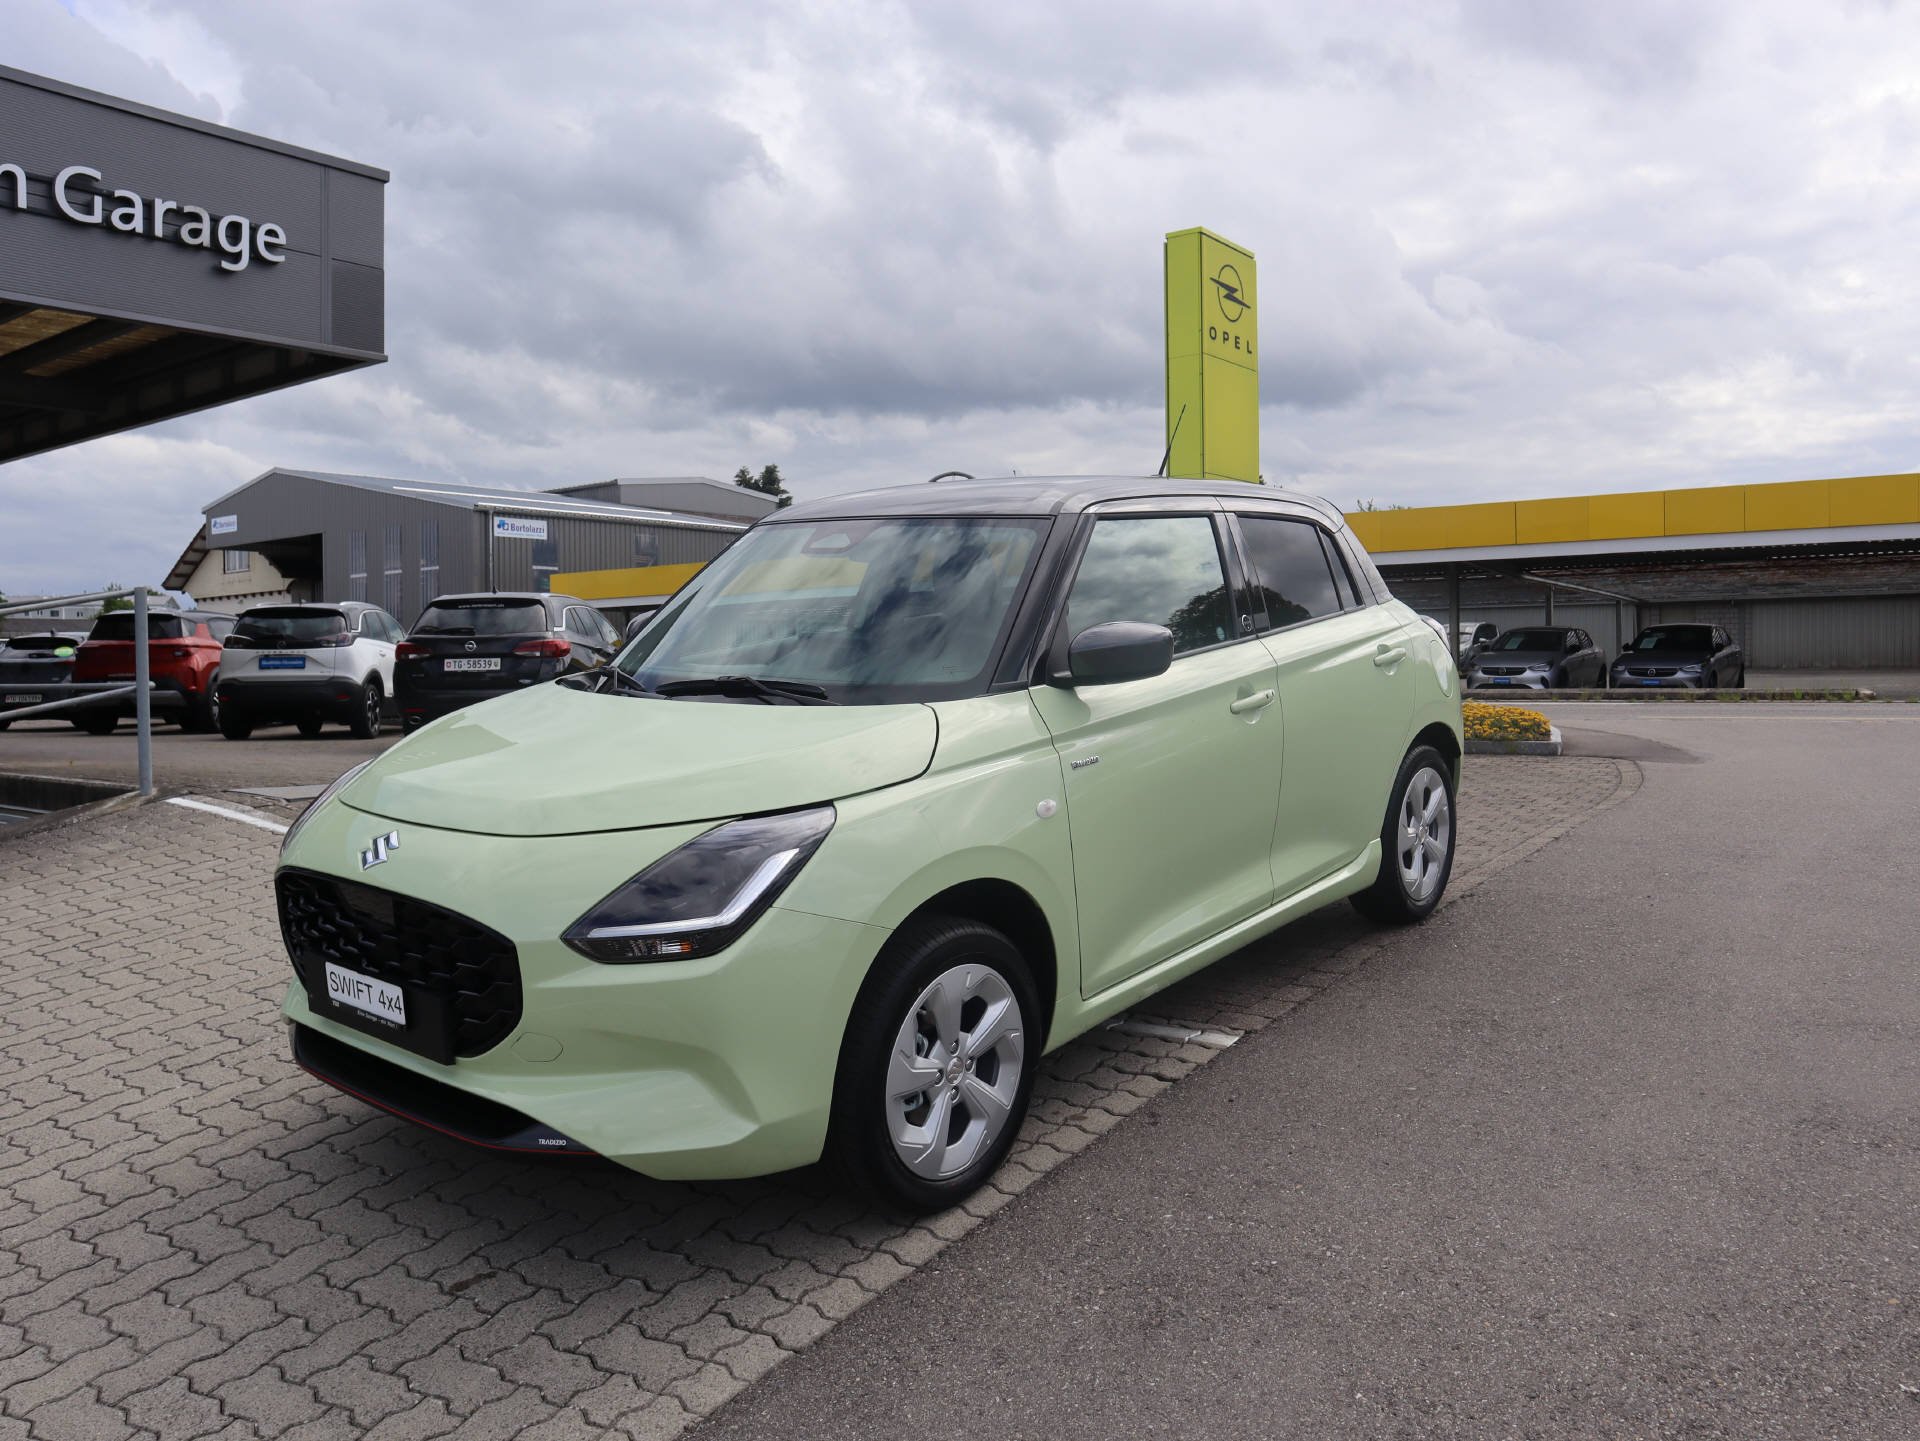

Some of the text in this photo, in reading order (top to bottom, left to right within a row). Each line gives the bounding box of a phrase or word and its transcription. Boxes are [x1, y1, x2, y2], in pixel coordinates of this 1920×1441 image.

[54, 165, 287, 272] Garage
[1208, 326, 1253, 354] OPEL
[510, 523, 545, 534] Bortolazzi
[329, 971, 403, 1015] SWIFT 4x4
